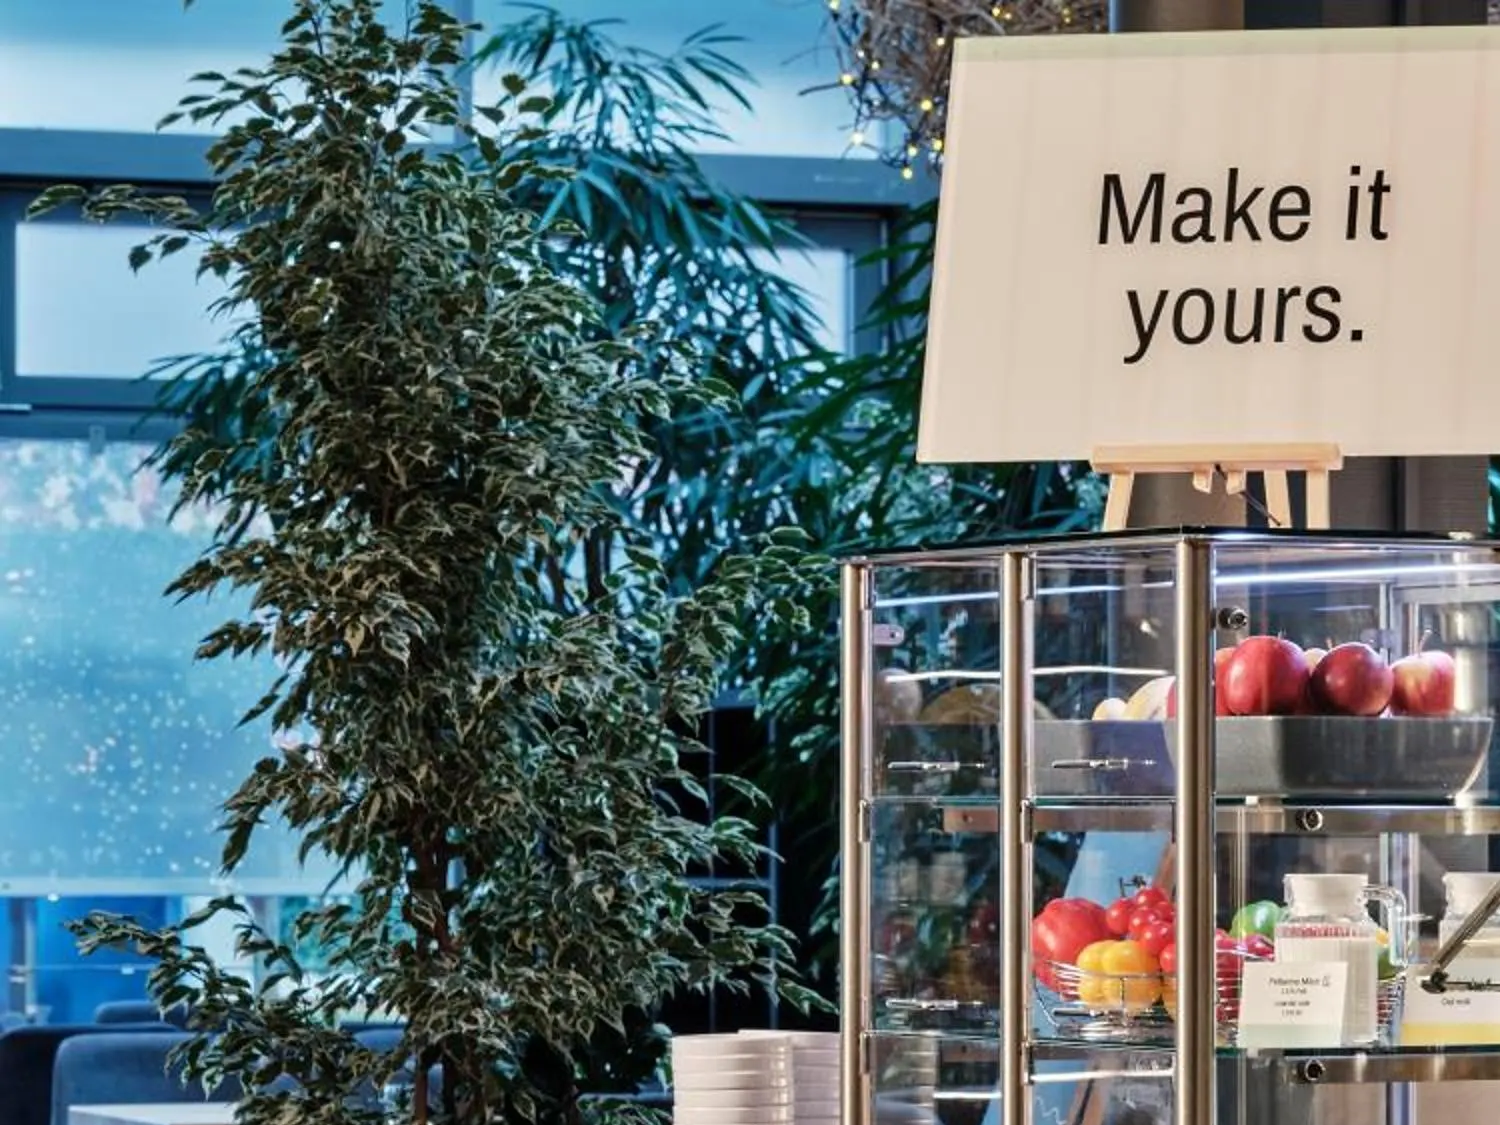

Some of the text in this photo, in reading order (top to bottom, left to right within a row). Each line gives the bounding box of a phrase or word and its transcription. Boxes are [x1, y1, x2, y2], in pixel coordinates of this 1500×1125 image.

[1097, 165, 1391, 245] Make it
[1122, 281, 1365, 364] yours.
